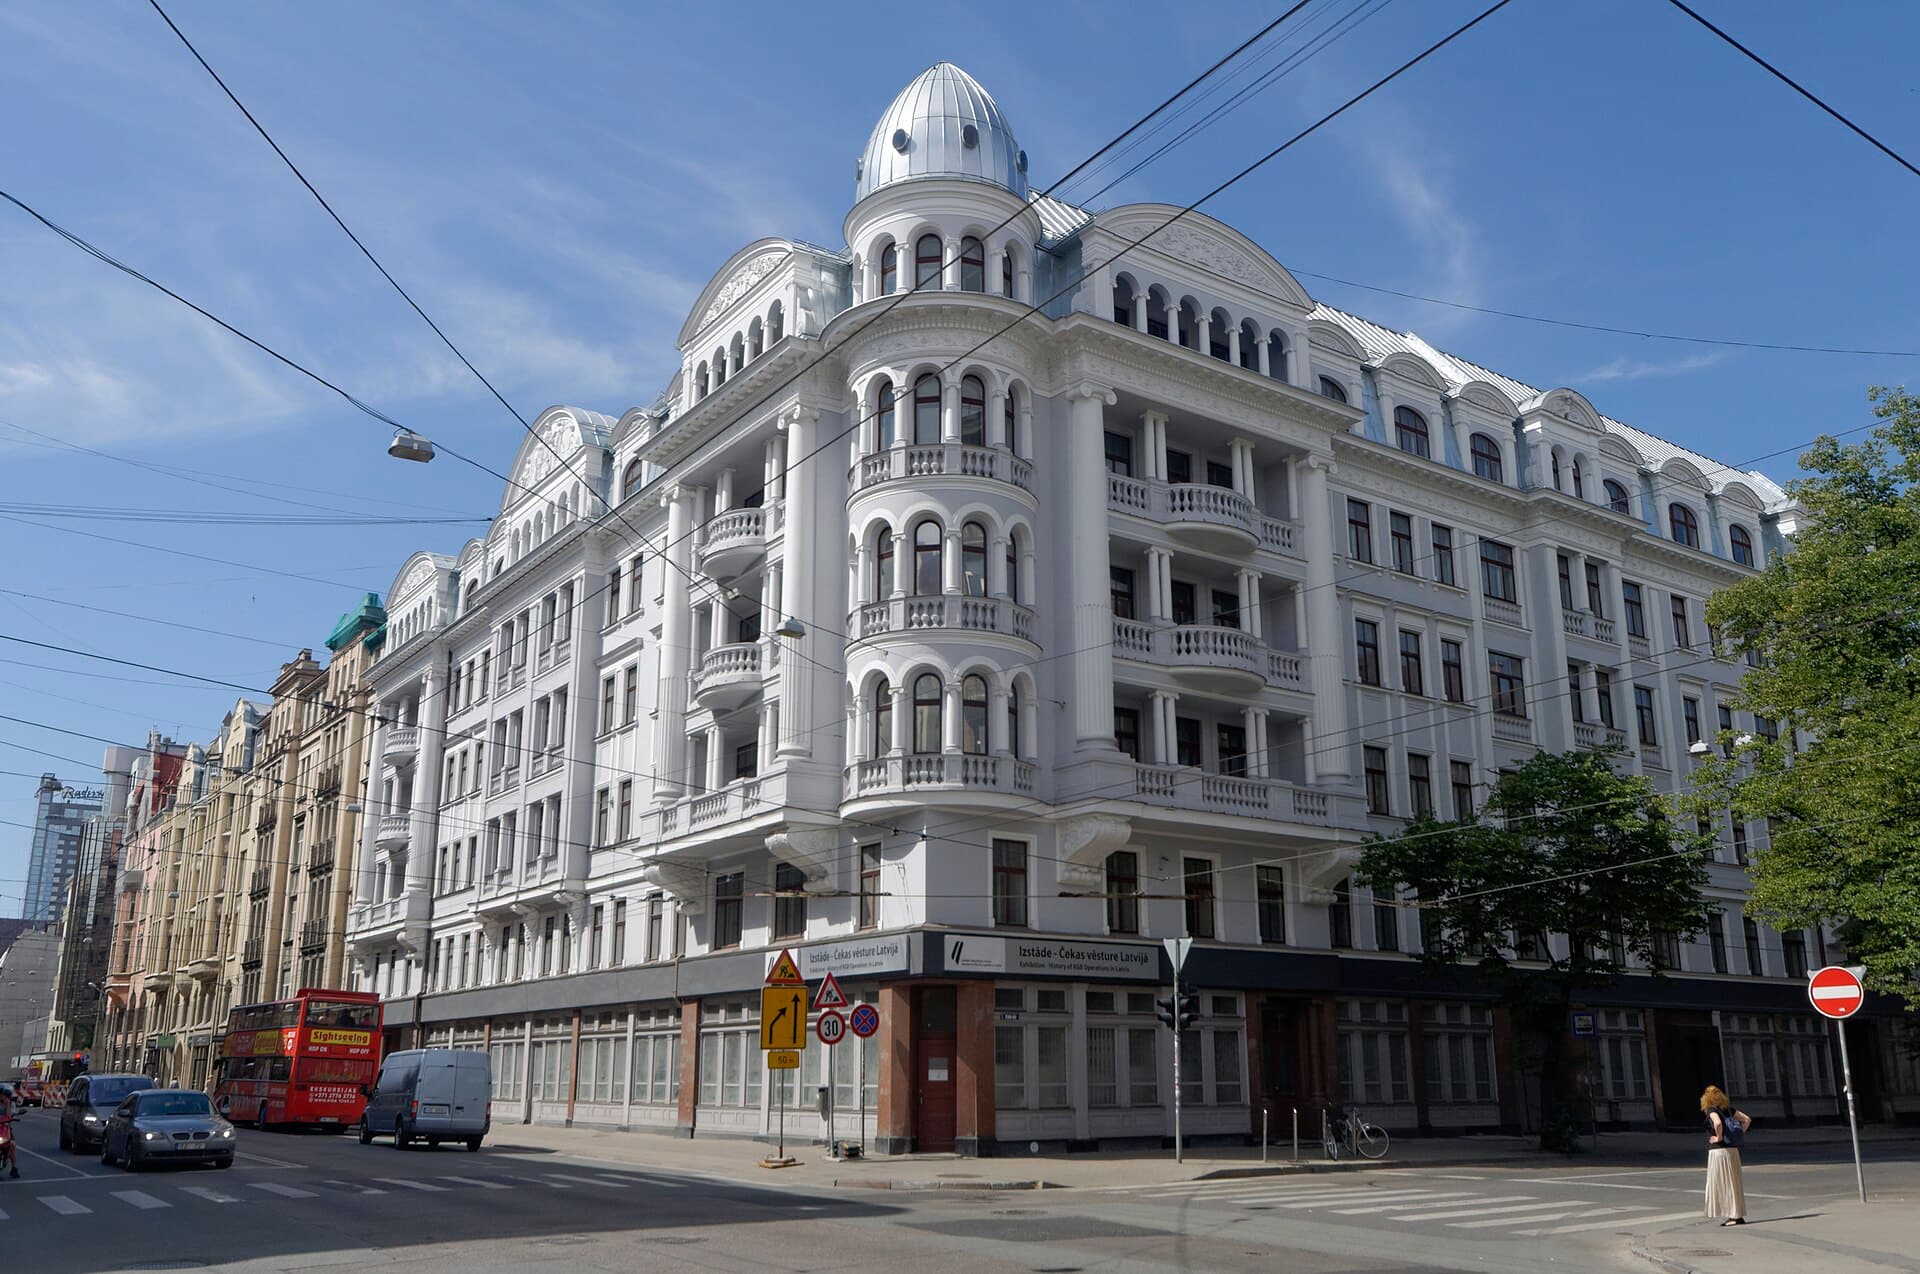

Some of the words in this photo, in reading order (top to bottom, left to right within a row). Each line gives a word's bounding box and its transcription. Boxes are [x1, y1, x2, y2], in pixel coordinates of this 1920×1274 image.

[1019, 945, 1052, 959] Izstāde
[1059, 945, 1085, 960] Čekas
[1087, 948, 1118, 962] vēsture
[1120, 950, 1149, 965] Latvijā
[824, 1019, 839, 1037] 30
[313, 1031, 368, 1044] Sightseeing
